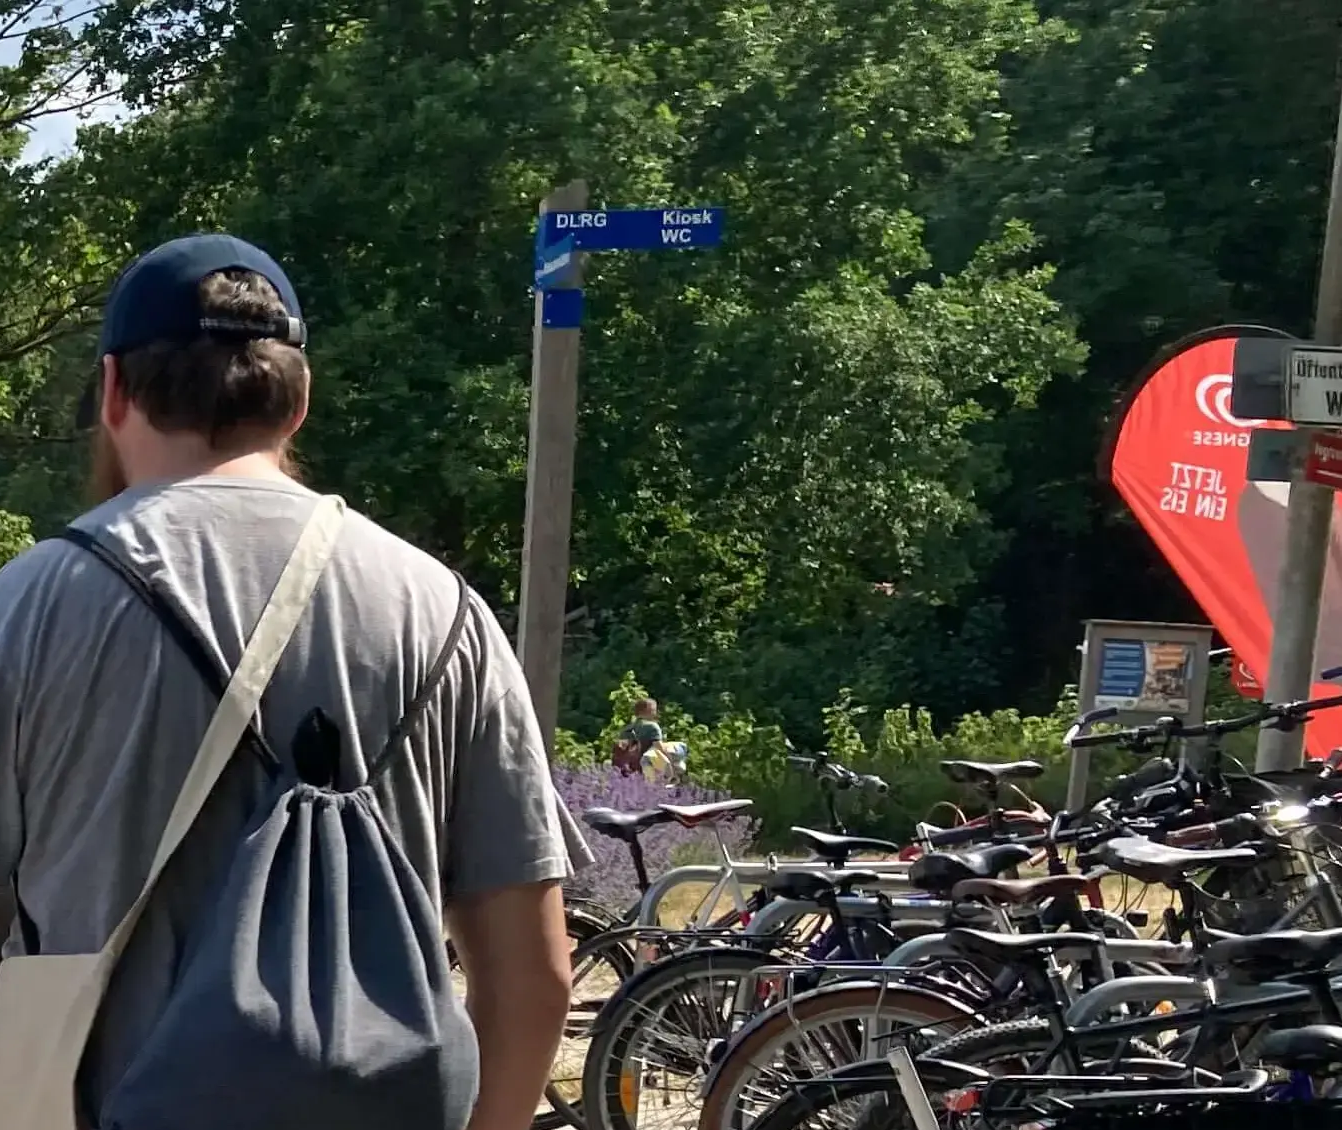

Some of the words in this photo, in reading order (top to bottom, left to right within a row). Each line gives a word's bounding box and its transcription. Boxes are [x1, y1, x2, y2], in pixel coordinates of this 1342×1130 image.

[556, 213, 607, 228] DLRG
[663, 210, 712, 225] Kiosk
[661, 228, 692, 243] WC
